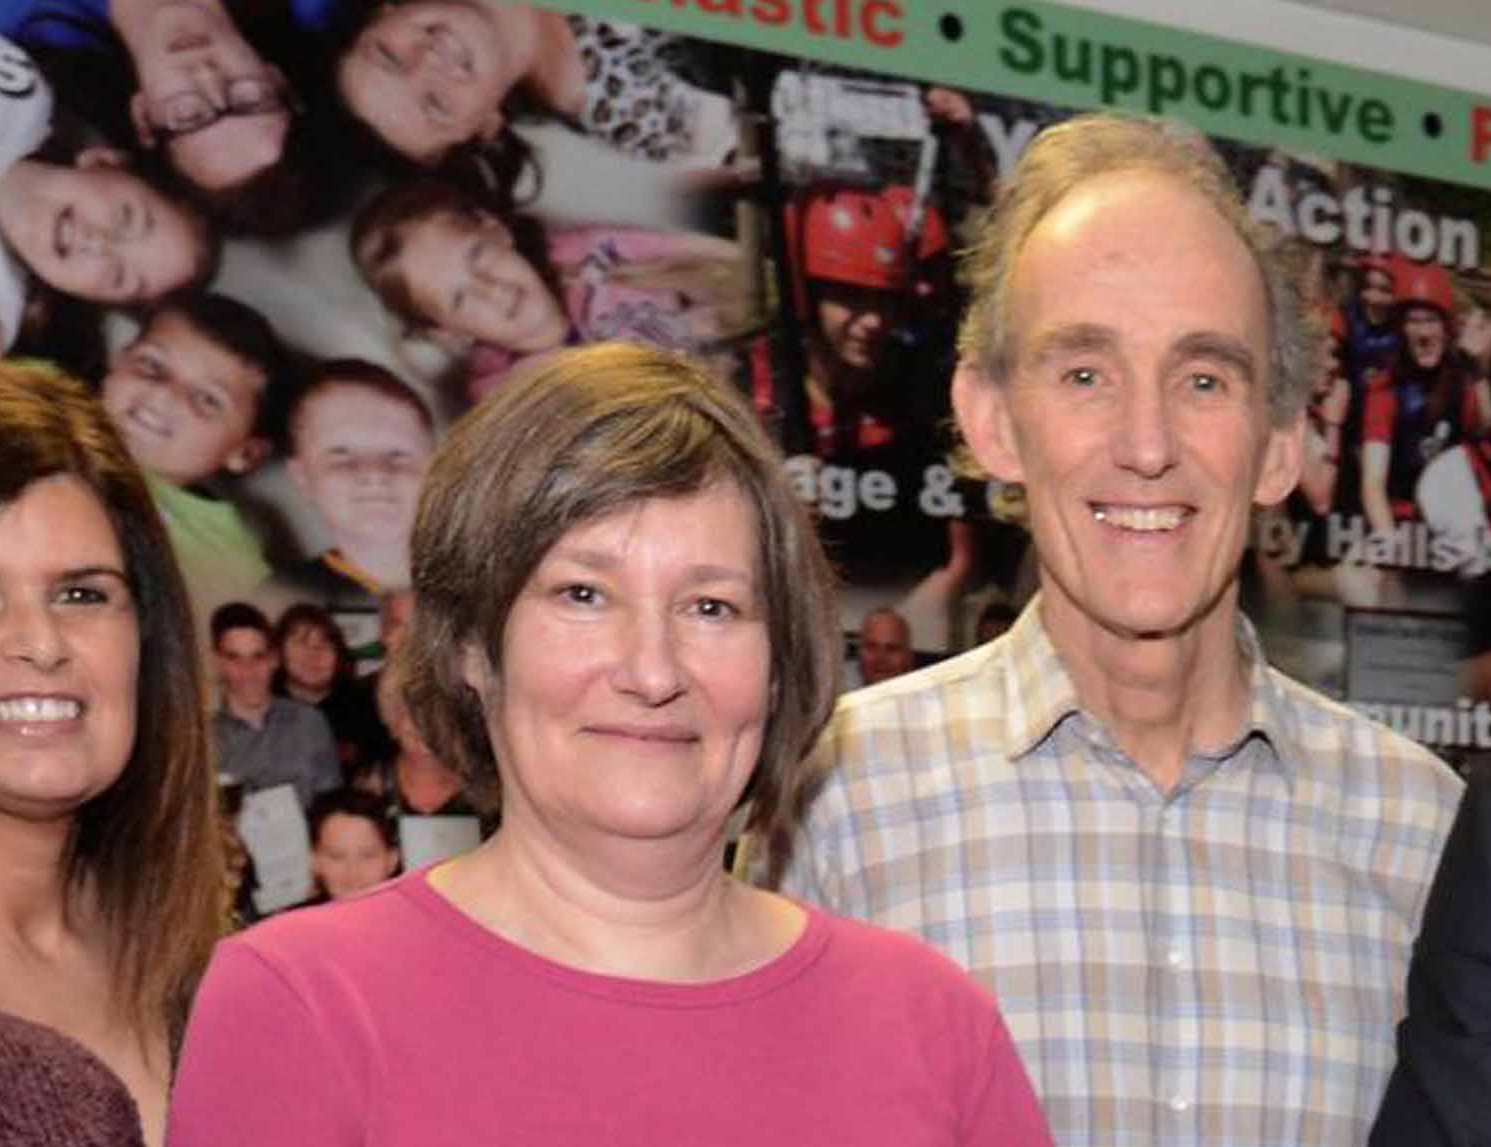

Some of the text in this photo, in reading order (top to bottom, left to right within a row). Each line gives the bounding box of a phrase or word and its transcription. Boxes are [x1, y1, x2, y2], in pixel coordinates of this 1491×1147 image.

[998, 8, 1395, 143] Supportive
[1248, 163, 1482, 270] Action
[918, 463, 965, 519] &
[1327, 513, 1464, 573] Halls
